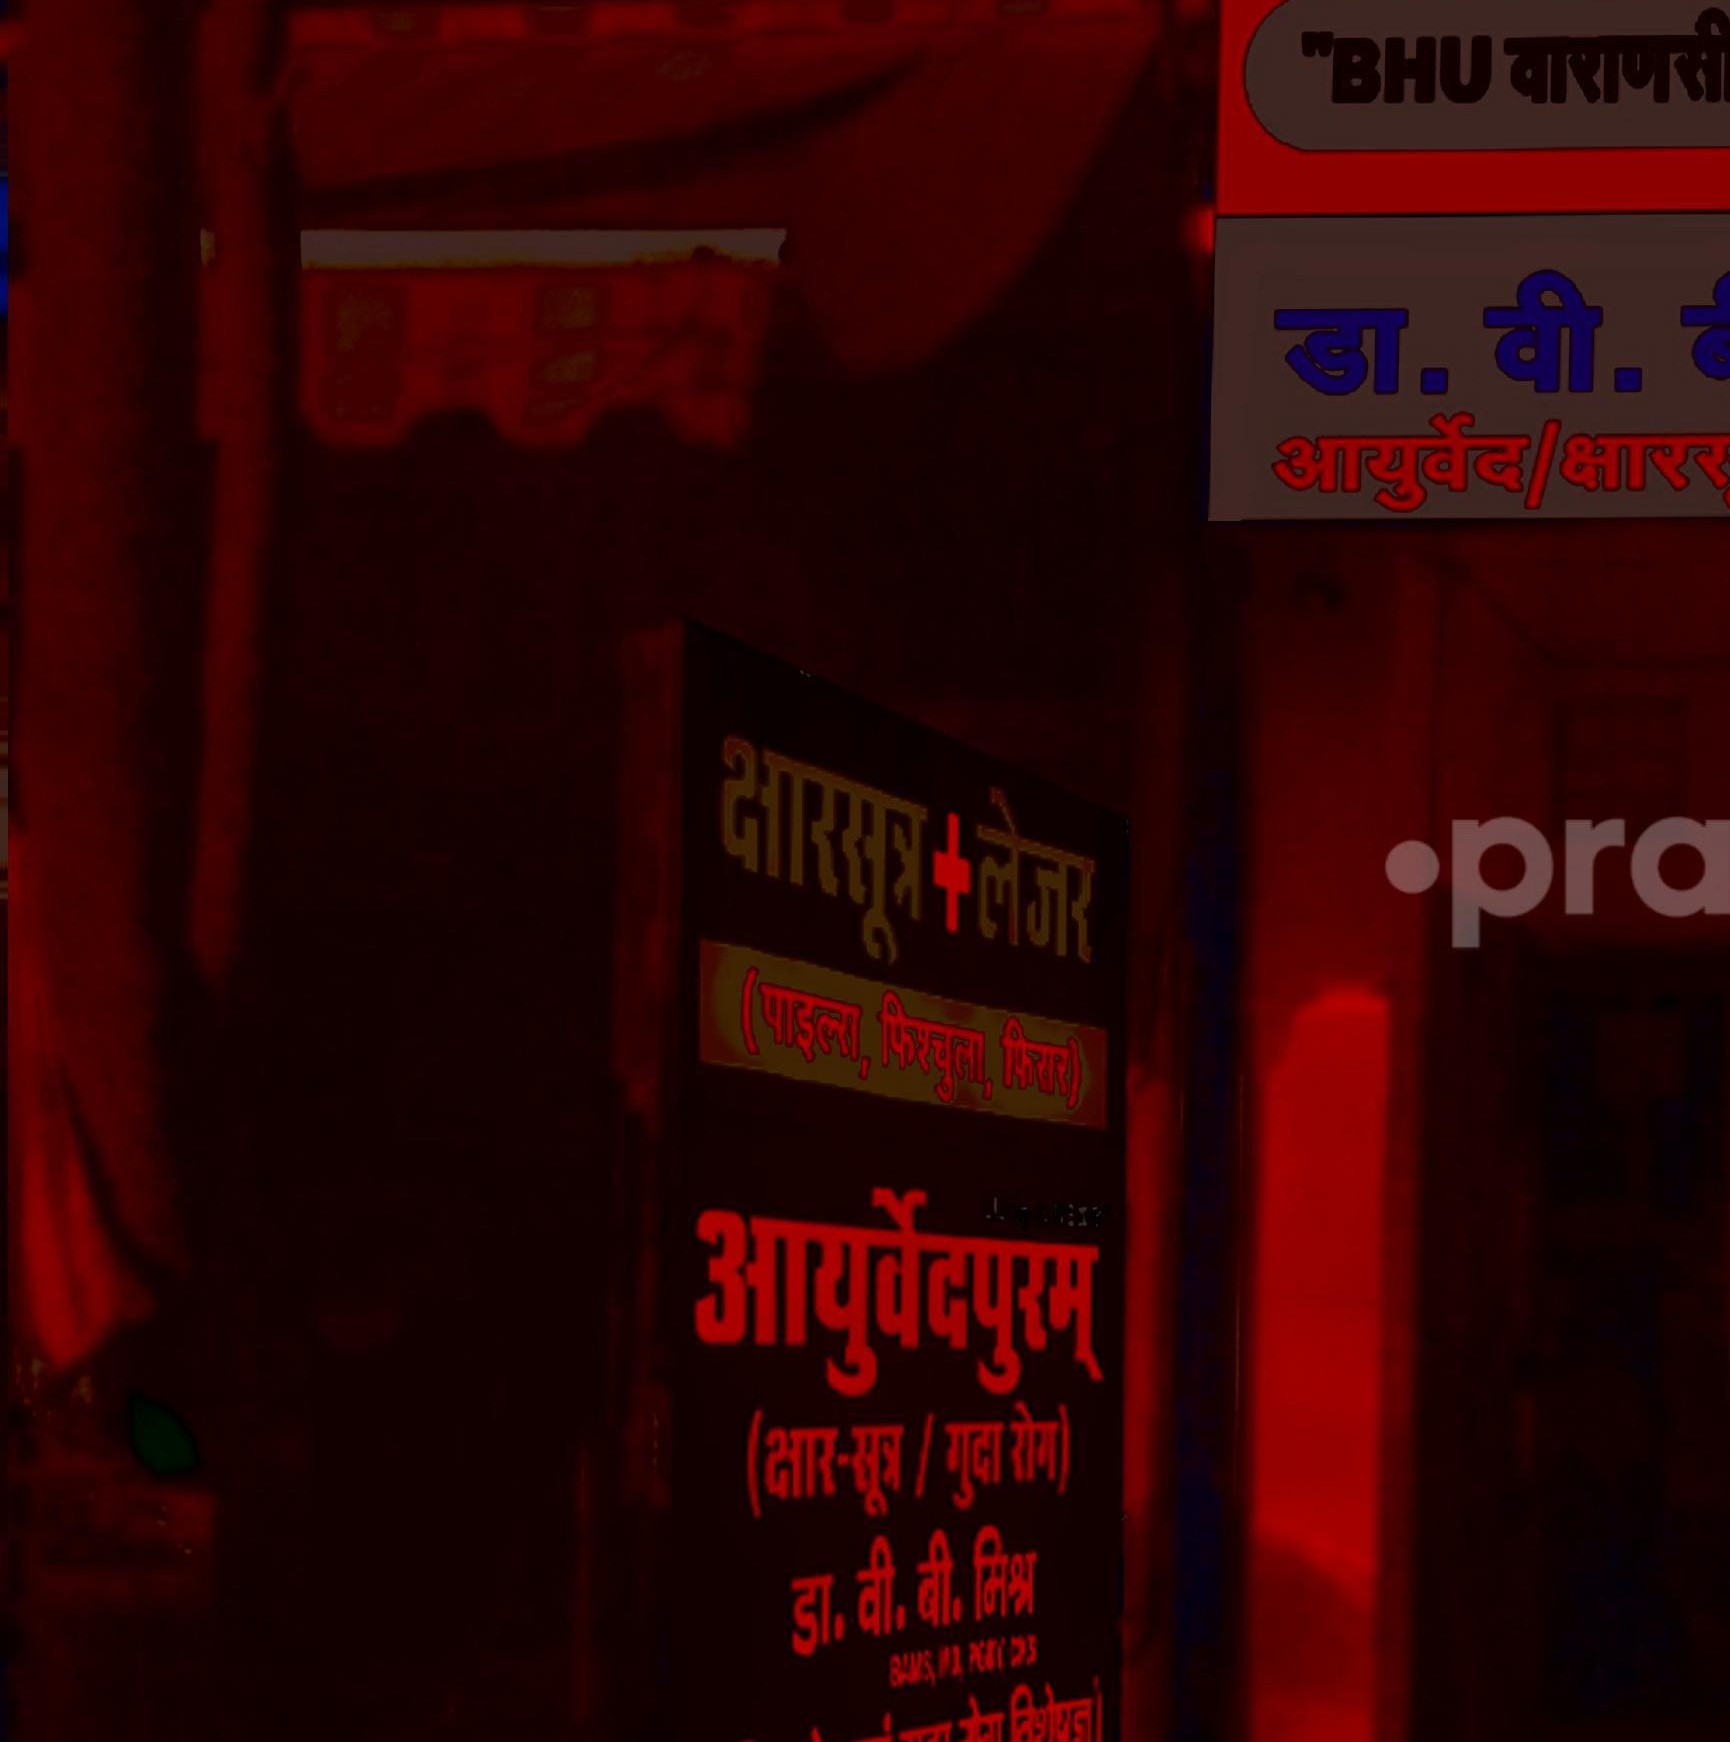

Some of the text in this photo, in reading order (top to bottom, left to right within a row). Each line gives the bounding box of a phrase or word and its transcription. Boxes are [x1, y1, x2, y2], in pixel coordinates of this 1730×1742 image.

[1274, 308, 1449, 395] डा.
[1484, 269, 1643, 393] वी.
[721, 735, 928, 966] क्षारसूत्र
[976, 786, 1096, 964] लेजर
[695, 1186, 1104, 1397] आयुर्वेदपुरम्
[945, 1421, 1005, 1510] गुदा
[1010, 1400, 1071, 1497] रोग)
[790, 1573, 845, 1657] डा.
[857, 1534, 906, 1637] वी.
[973, 1525, 1038, 1622] मिश्र
